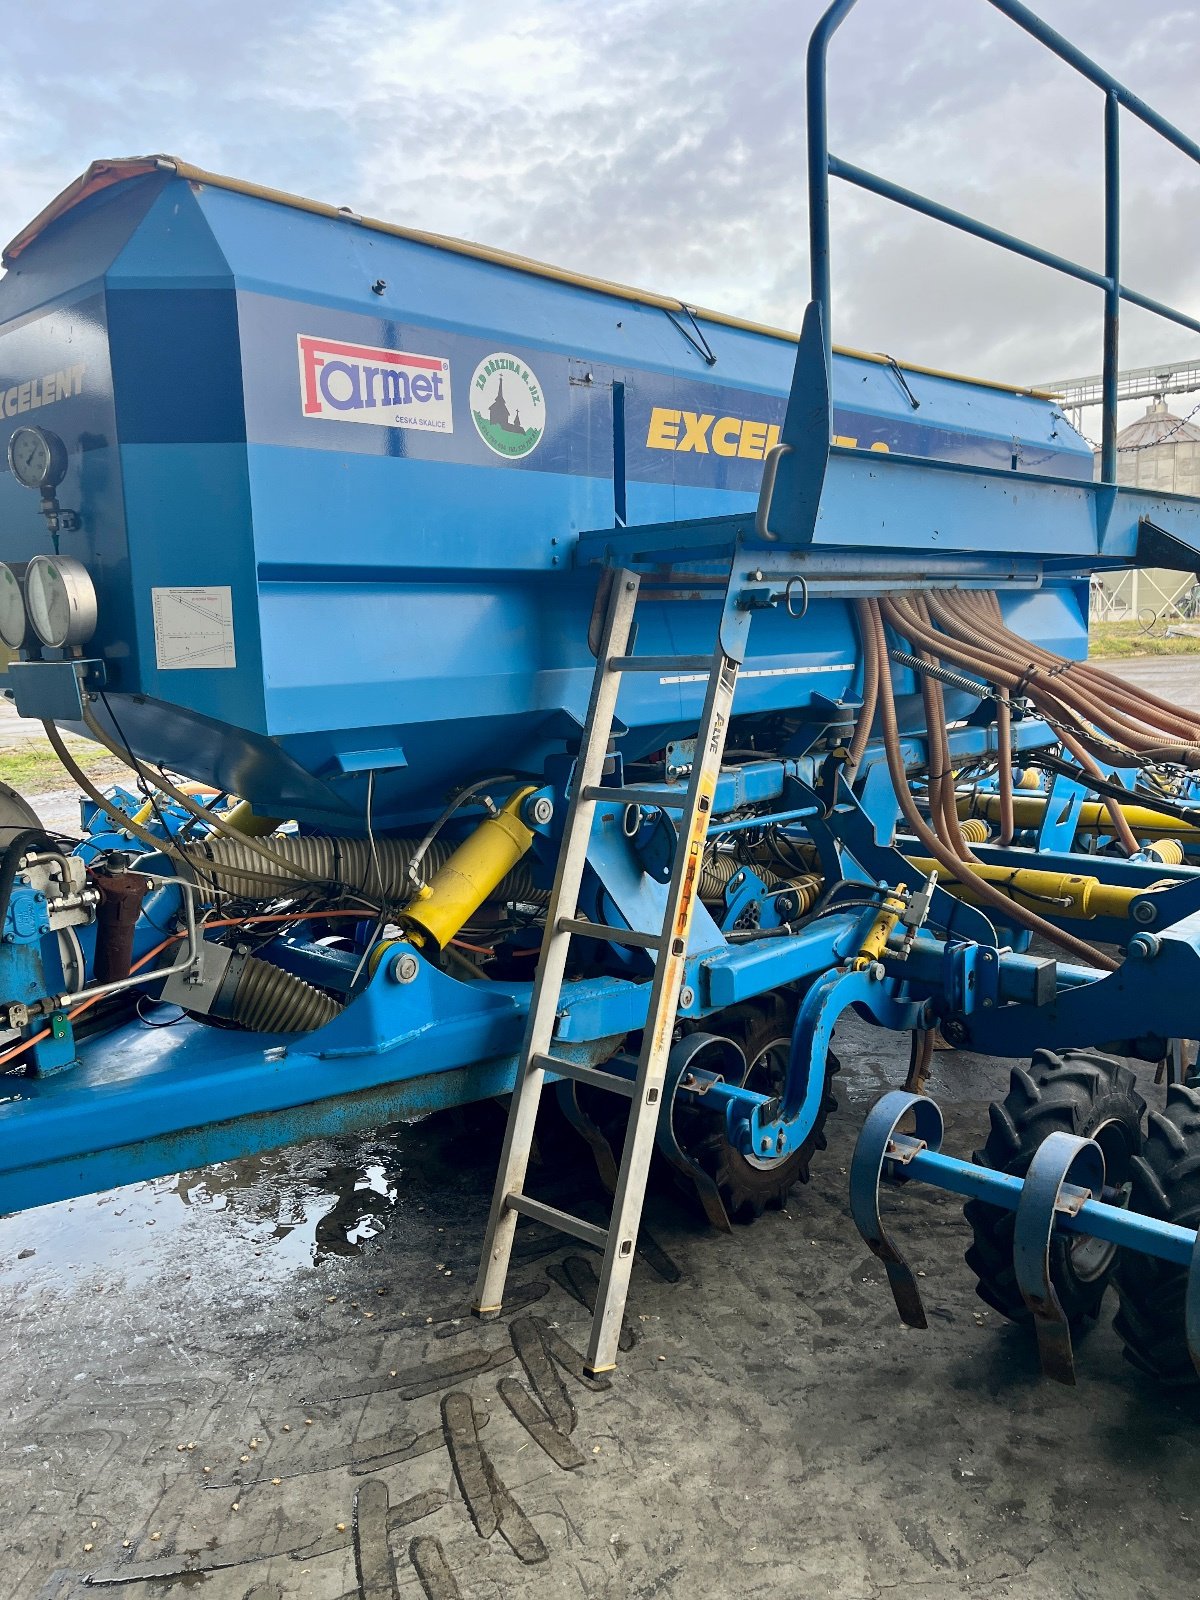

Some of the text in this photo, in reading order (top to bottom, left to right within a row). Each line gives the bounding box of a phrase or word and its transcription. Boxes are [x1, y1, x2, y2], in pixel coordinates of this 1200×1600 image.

[300, 337, 444, 413] Farmet
[476, 374, 487, 391] ZD
[484, 359, 520, 376] BŘEZINA
[395, 415, 446, 429] ČESKÁ SKALICE
